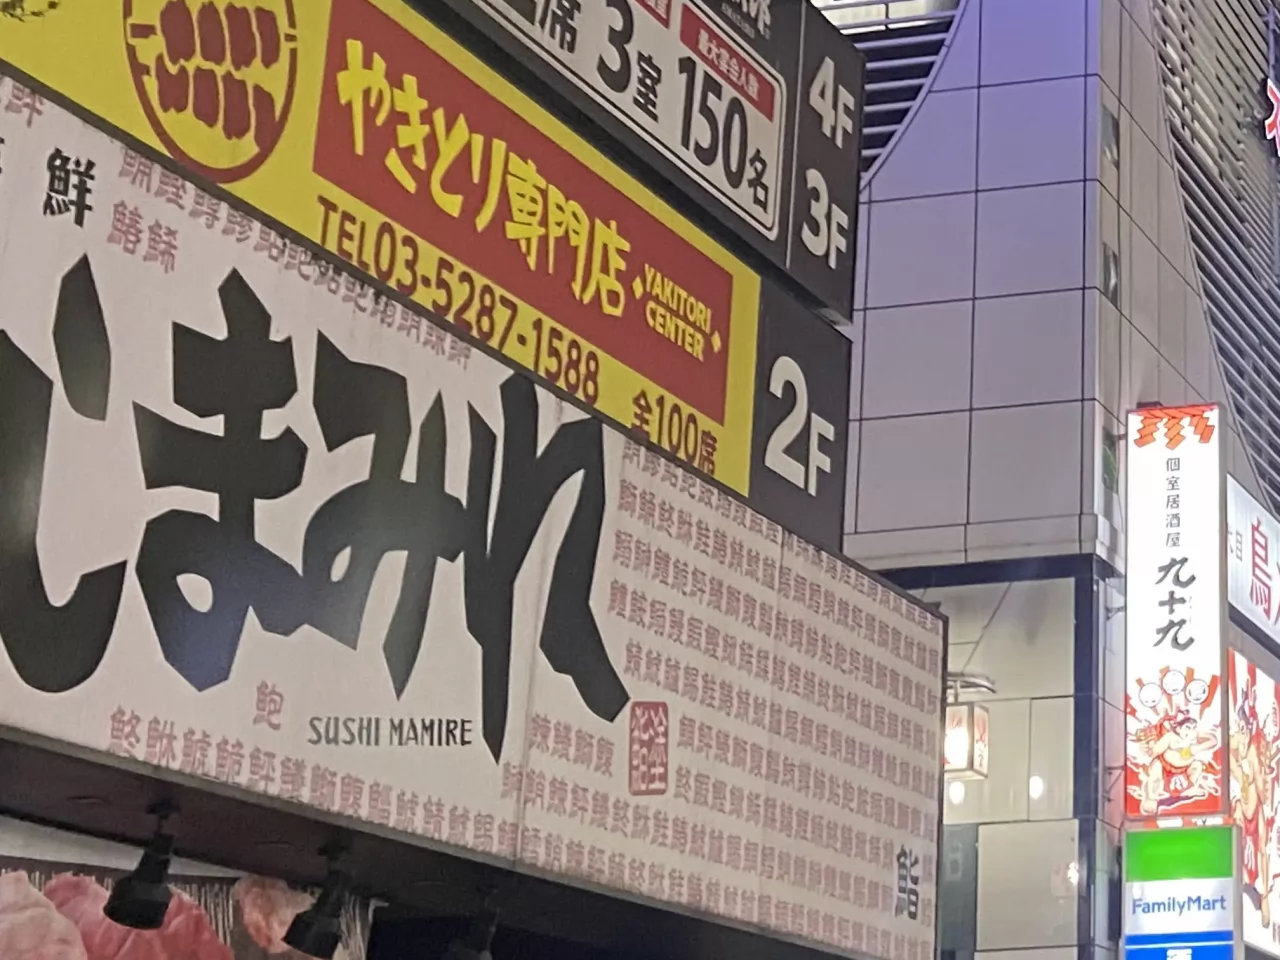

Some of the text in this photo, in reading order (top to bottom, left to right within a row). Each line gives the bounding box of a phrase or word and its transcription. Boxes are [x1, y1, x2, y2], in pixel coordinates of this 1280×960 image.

[810, 56, 855, 149] 4F
[337, 39, 631, 318] やきとり専門店
[801, 168, 849, 269] 3F
[645, 263, 712, 328] YAKITORI
[646, 299, 704, 362] CENTER
[631, 389, 718, 475] 全100席
[764, 356, 835, 497] 2F
[1165, 457, 1181, 548] 個室居酒屋
[1153, 557, 1197, 652] 九十九
[308, 716, 472, 746] SUSHI MAMIRE
[1132, 895, 1227, 916] FamilyMart
